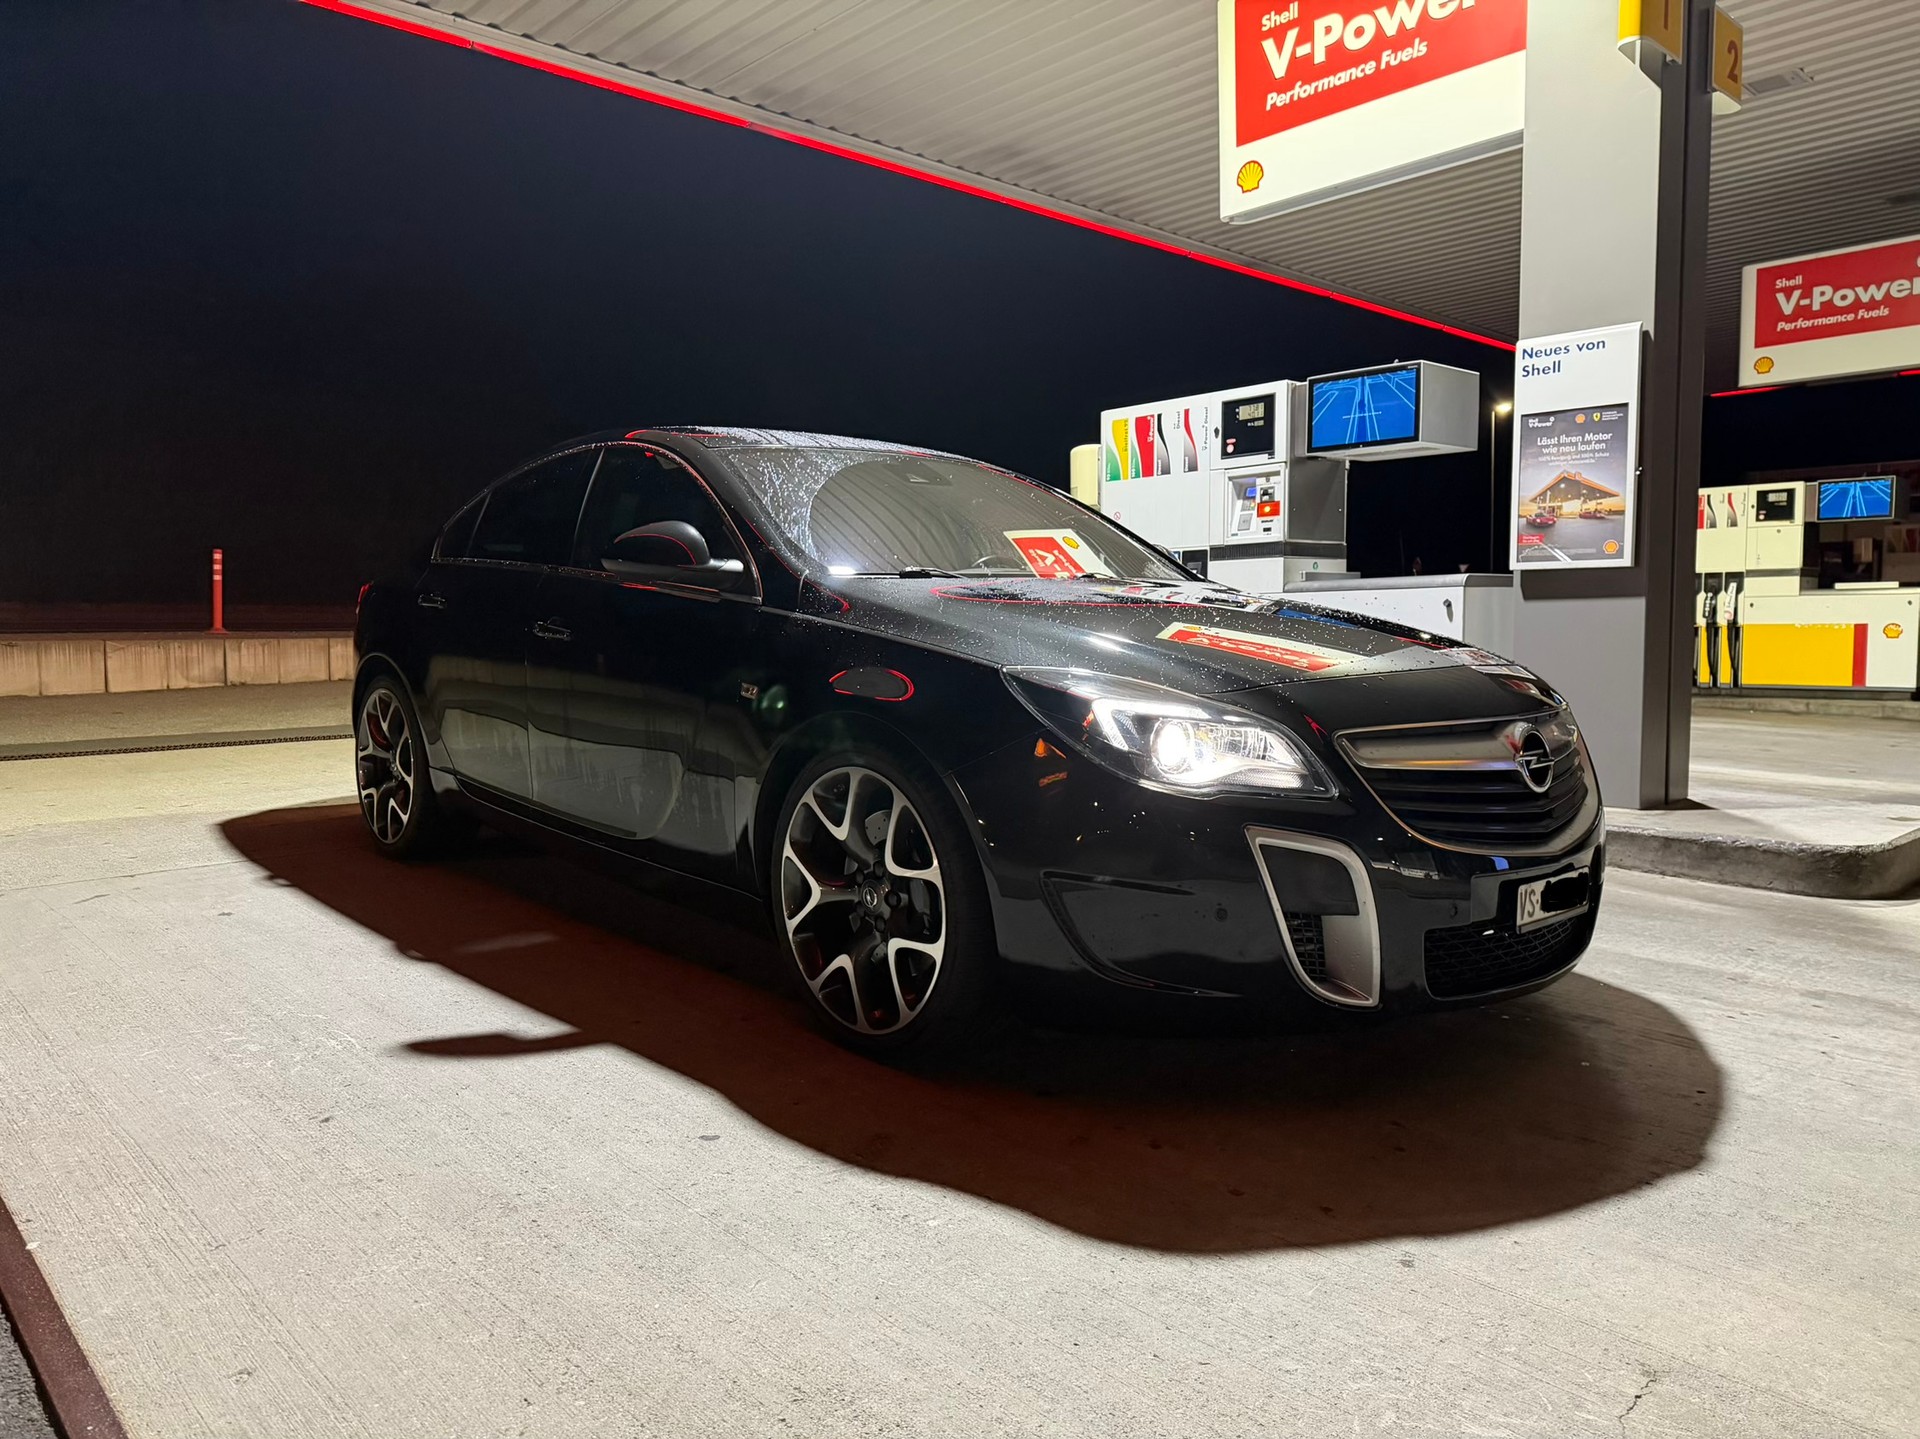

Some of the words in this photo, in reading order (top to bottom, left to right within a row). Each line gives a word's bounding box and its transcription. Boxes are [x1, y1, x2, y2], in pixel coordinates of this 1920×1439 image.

[1261, 1, 1298, 31] Shell
[1727, 39, 1739, 84] 2
[1265, 56, 1376, 111] Performance
[1380, 37, 1428, 71] Fuels
[1775, 275, 1803, 289] Shell
[1776, 313, 1855, 332] Performance
[1857, 305, 1890, 320] Fuels
[1522, 345, 1571, 360] Neues
[1576, 340, 1606, 352] von
[1522, 360, 1561, 377] Shell
[1537, 436, 1558, 446] Lässt
[1559, 434, 1582, 444] Ihren
[1584, 432, 1613, 442] Motor
[1542, 445, 1558, 454] wie
[1578, 441, 1606, 452] laufen
[1520, 888, 1536, 921] VS
